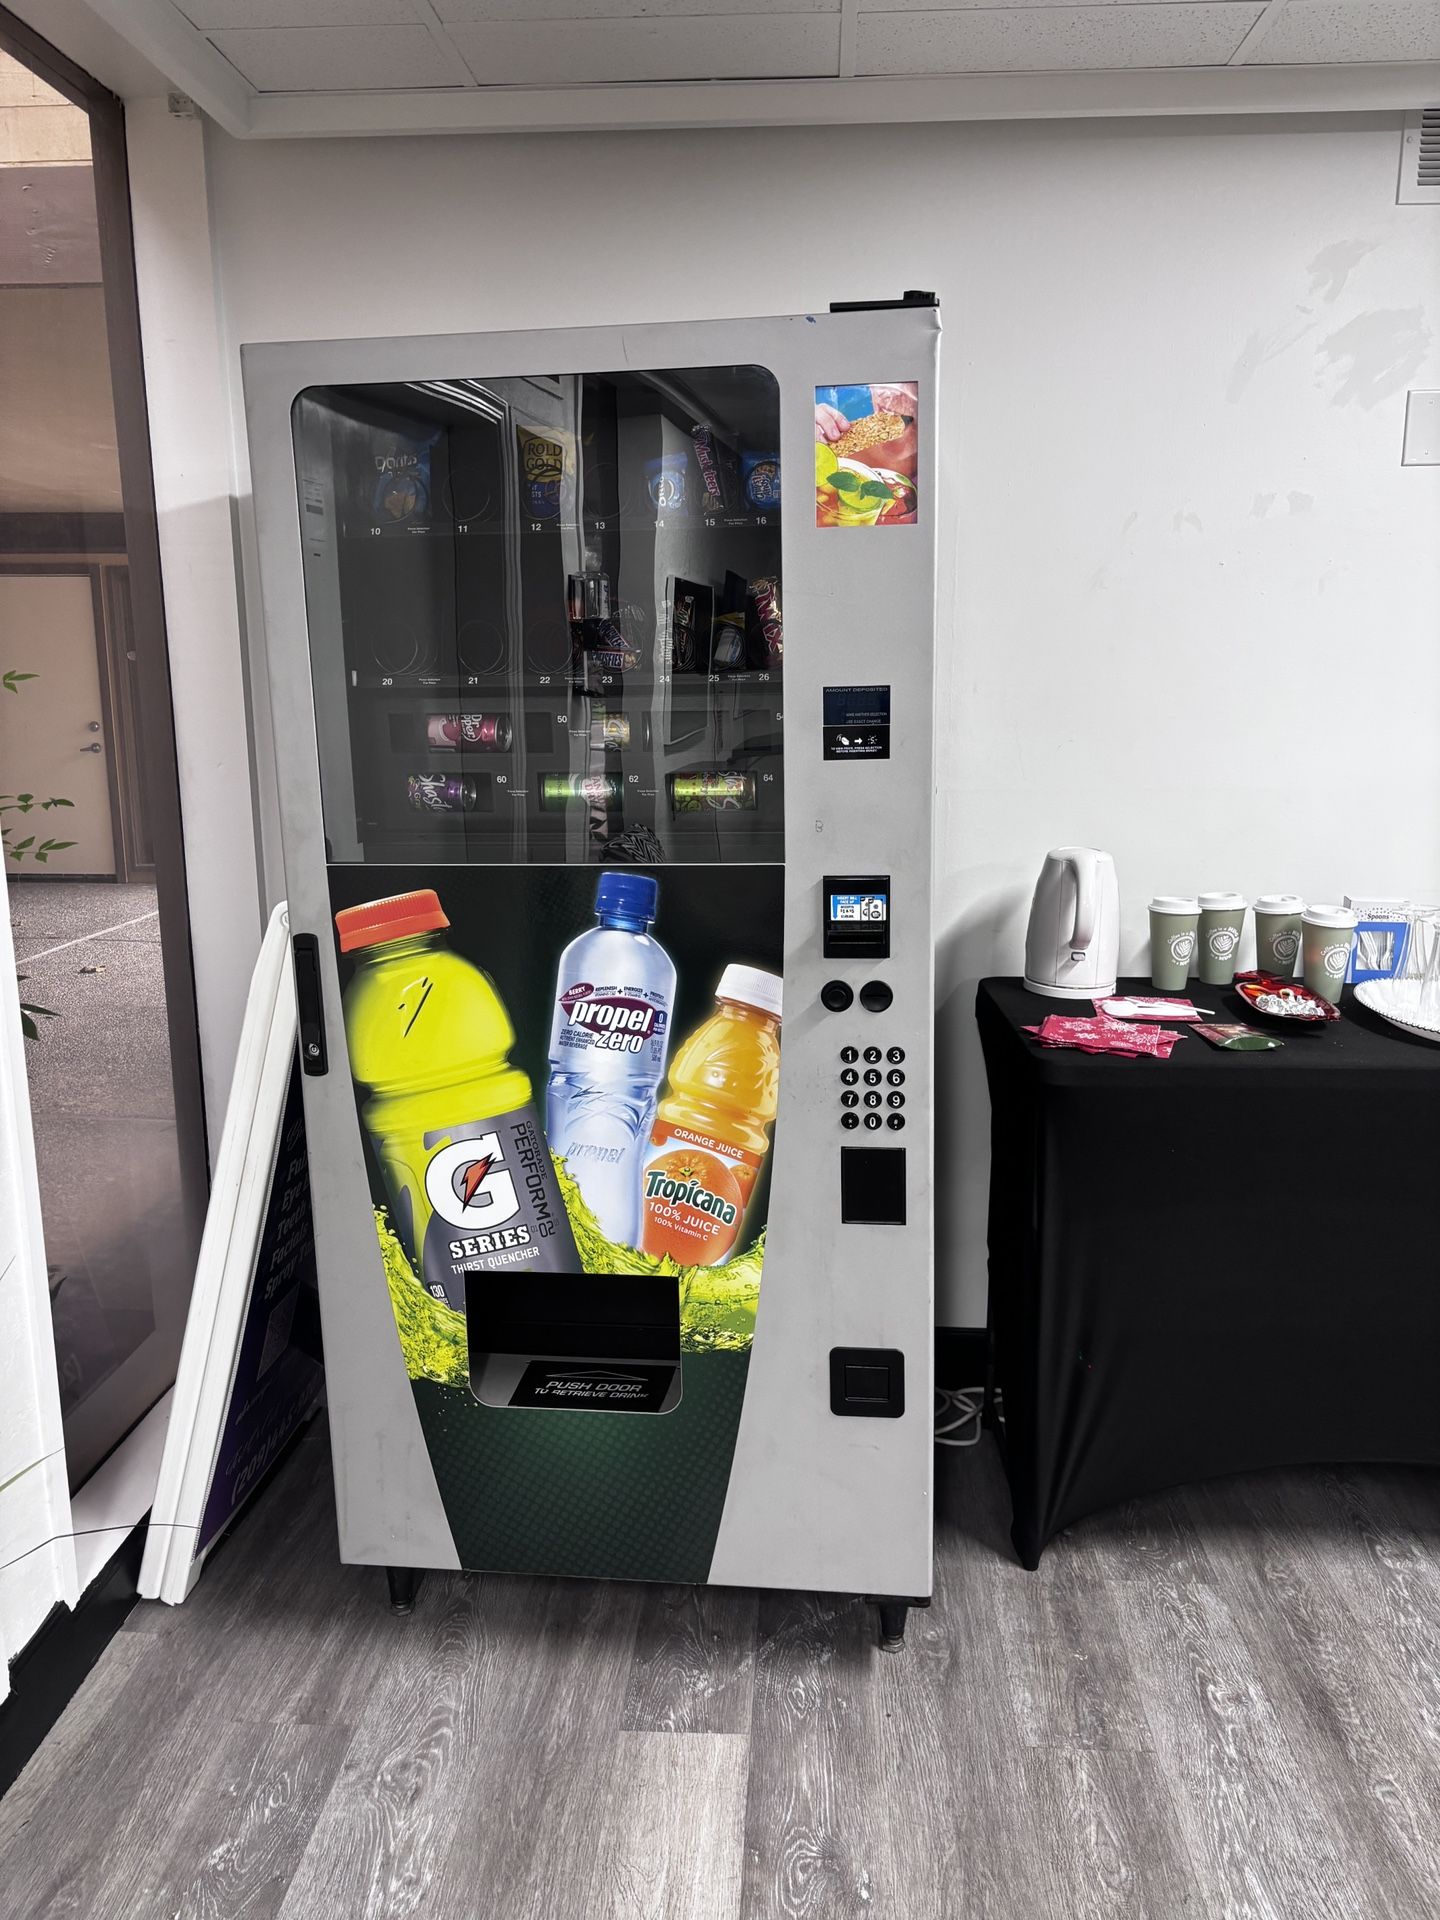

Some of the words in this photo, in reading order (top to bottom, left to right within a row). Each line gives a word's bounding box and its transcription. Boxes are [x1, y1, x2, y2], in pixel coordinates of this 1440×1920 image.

[528, 443, 562, 456] ROLD
[527, 458, 562, 471] GOLD
[595, 521, 606, 530] 13
[654, 520, 664, 528] 14
[705, 518, 716, 526] 15
[756, 516, 767, 525] 16
[370, 527, 381, 535] 10
[458, 525, 468, 533] 11
[531, 523, 542, 531] 12
[382, 677, 393, 686] 20
[468, 676, 478, 685] 21
[539, 676, 550, 685] 22
[602, 675, 613, 684] 23
[659, 675, 670, 683] 24
[708, 674, 720, 682] 25
[758, 673, 770, 681] 26
[470, 714, 482, 728] Dr
[557, 715, 568, 724] 50
[461, 714, 476, 739] pper
[497, 776, 507, 784] 60
[628, 775, 639, 783] 62
[763, 774, 774, 782] 64
[1367, 913, 1390, 921] Spoons
[568, 985, 586, 996] BERRY
[569, 1000, 653, 1034] propel
[595, 1029, 644, 1053] zero
[846, 1050, 852, 1061] 1
[869, 1050, 877, 1061] 2
[892, 1050, 901, 1062] 3
[846, 1071, 853, 1082] 4
[869, 1072, 877, 1083] 5
[892, 1073, 901, 1084] 6
[846, 1094, 854, 1105] 7
[869, 1094, 877, 1106] 8
[892, 1095, 901, 1107] 9
[869, 1116, 877, 1127] 0
[674, 1128, 716, 1149] ORANGE
[715, 1142, 744, 1159] JUICE
[525, 1120, 548, 1179] GATORADE
[510, 1122, 552, 1221] PERFORM
[425, 1131, 521, 1231] G
[645, 1170, 737, 1226] Tropicana
[648, 1201, 682, 1221] 100%
[683, 1215, 720, 1235] JUICE
[538, 1221, 556, 1238] 02
[654, 1216, 673, 1228] 100%
[674, 1223, 702, 1239] Vitamin
[449, 1224, 532, 1261] SERIES
[451, 1260, 486, 1275] THIRST
[487, 1246, 540, 1270] QUENCHER
[430, 1284, 445, 1298] 130
[545, 1381, 592, 1390] PUSH
[595, 1383, 642, 1392] DOOR
[551, 1389, 607, 1398] RETRIEVE
